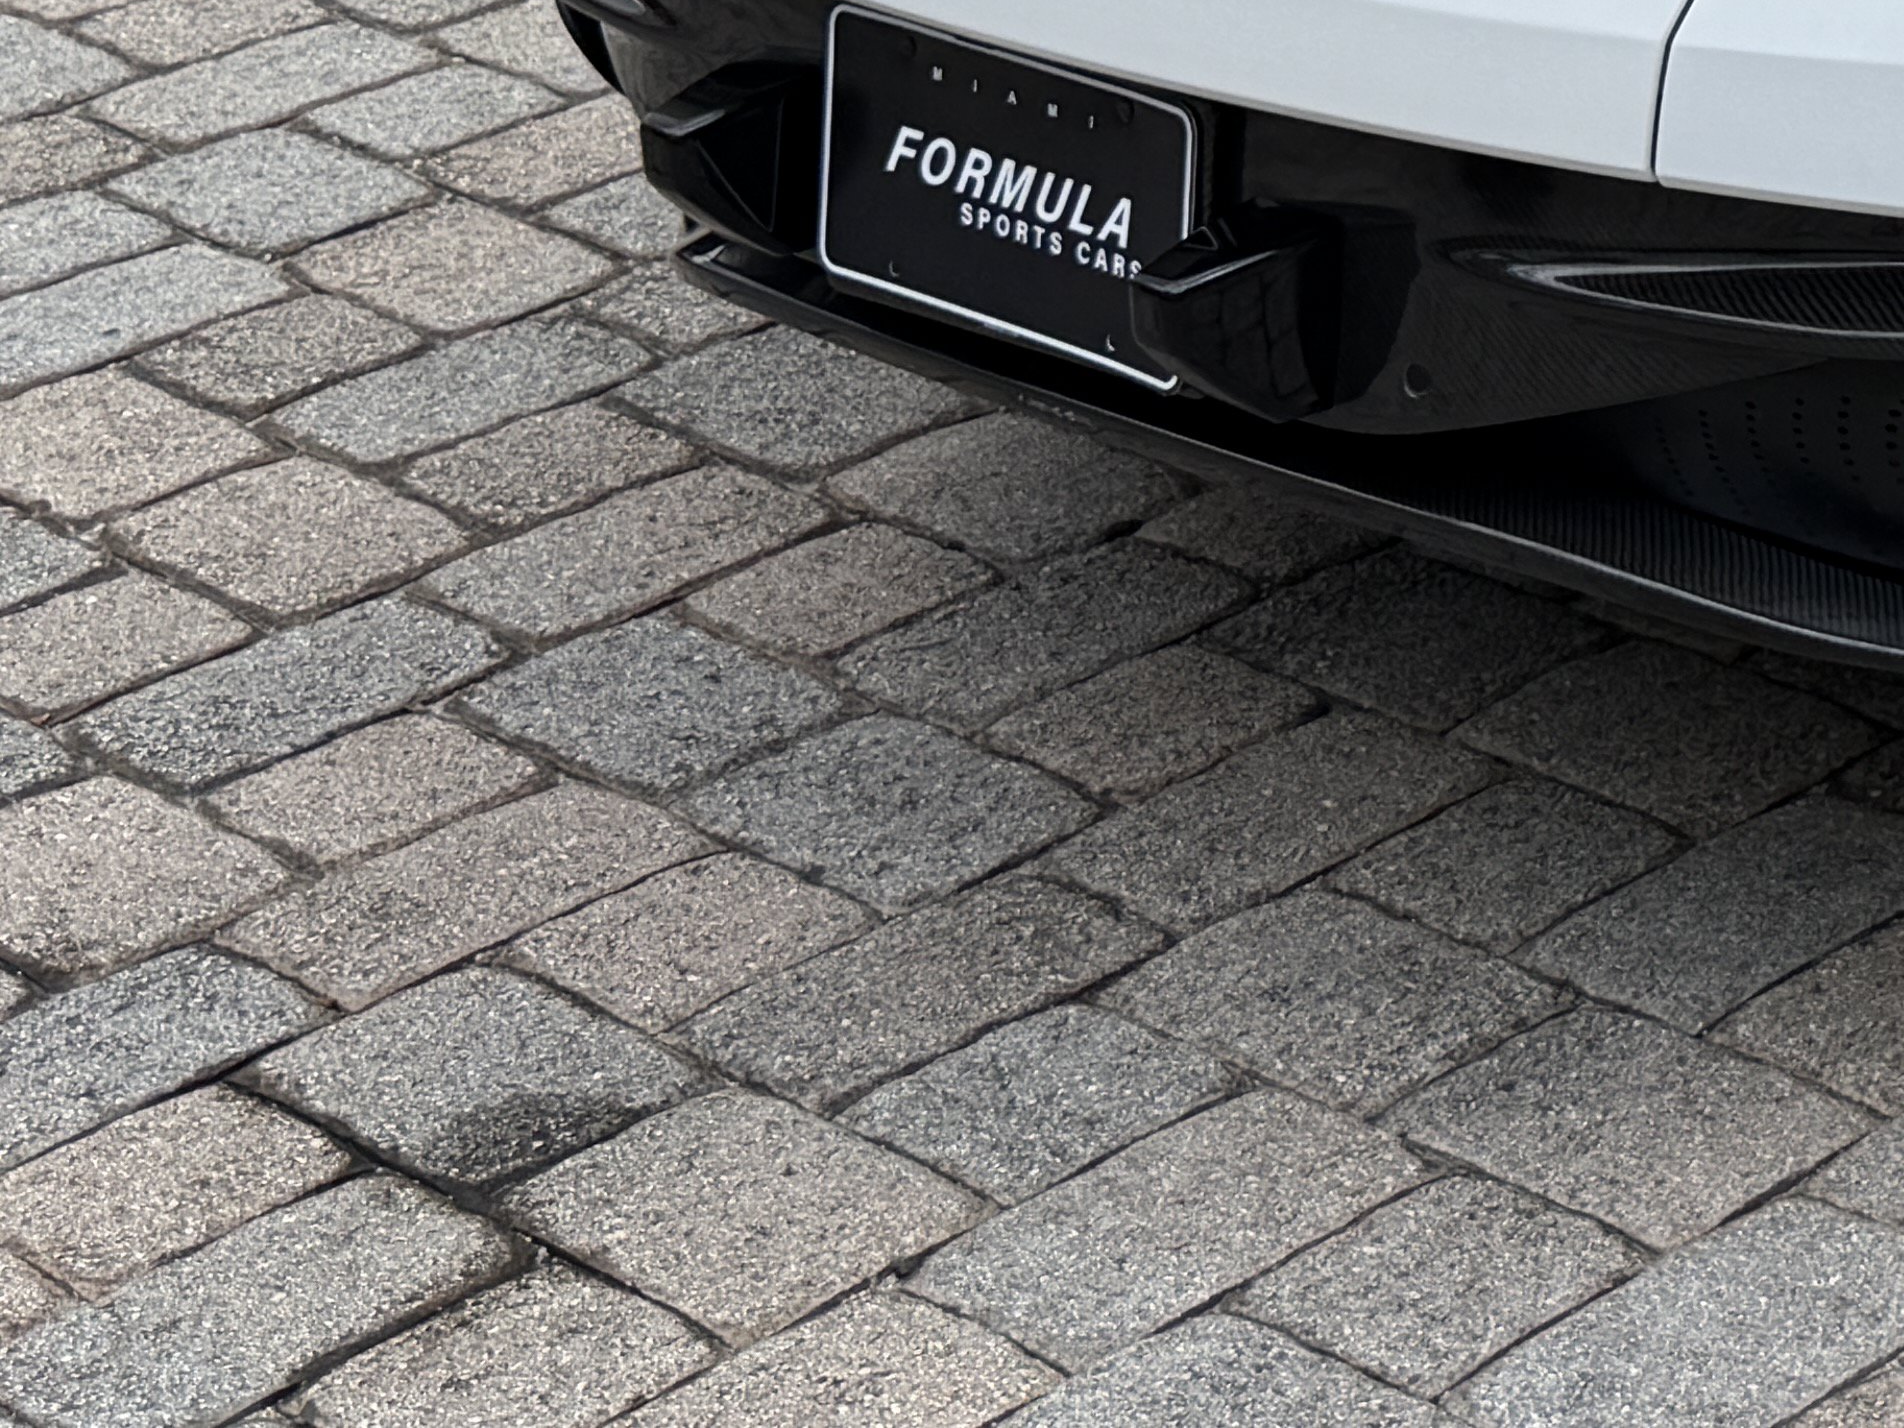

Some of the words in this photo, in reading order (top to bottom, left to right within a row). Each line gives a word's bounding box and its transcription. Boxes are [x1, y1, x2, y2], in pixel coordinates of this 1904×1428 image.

[931, 65, 1095, 129] MIAMI
[885, 125, 1132, 249] FORMULA
[960, 202, 1063, 256] SPORTS
